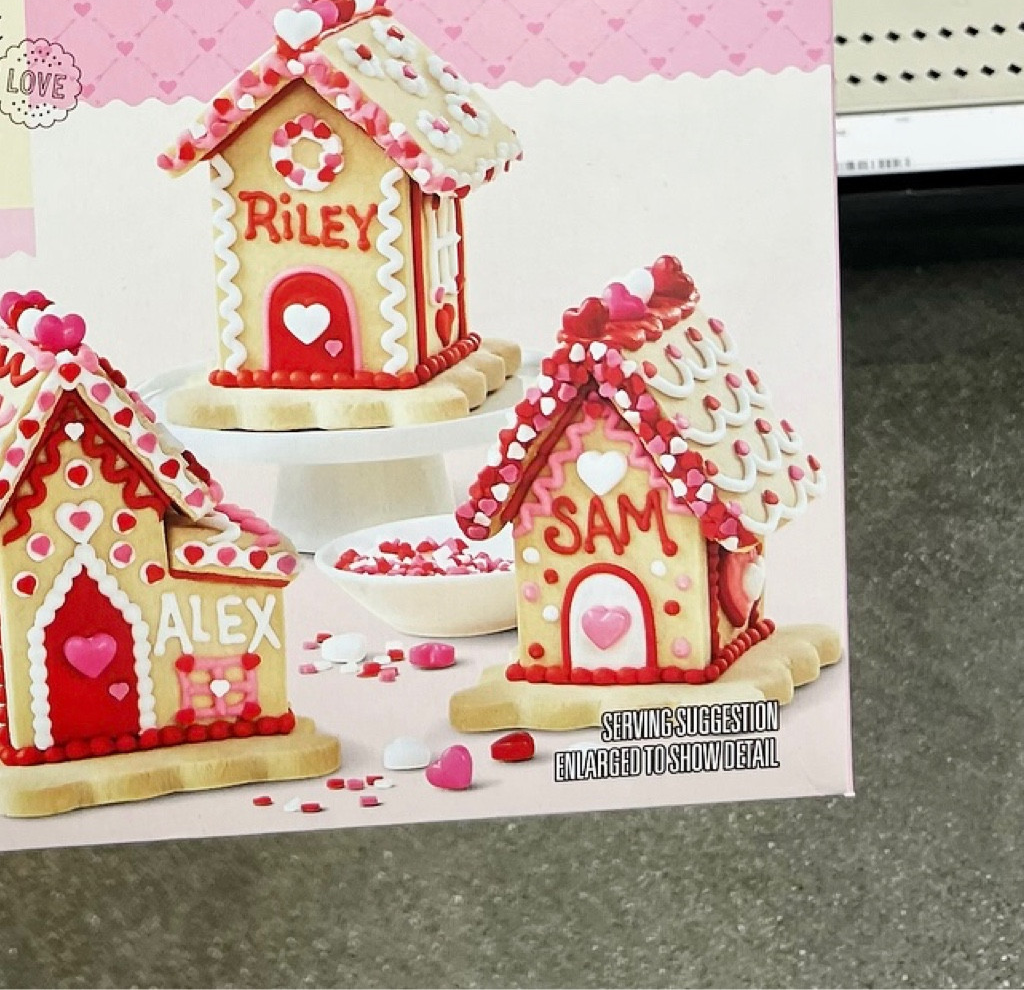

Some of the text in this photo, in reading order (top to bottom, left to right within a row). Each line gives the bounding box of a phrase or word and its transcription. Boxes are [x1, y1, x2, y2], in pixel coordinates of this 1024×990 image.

[6, 68, 67, 100] LOVE
[544, 489, 678, 557] SAM
[154, 592, 281, 656] ALEX
[601, 700, 780, 742] SERVING SUGGESTION
[555, 737, 780, 782] ENLARGED TO SHOW DETAIL
